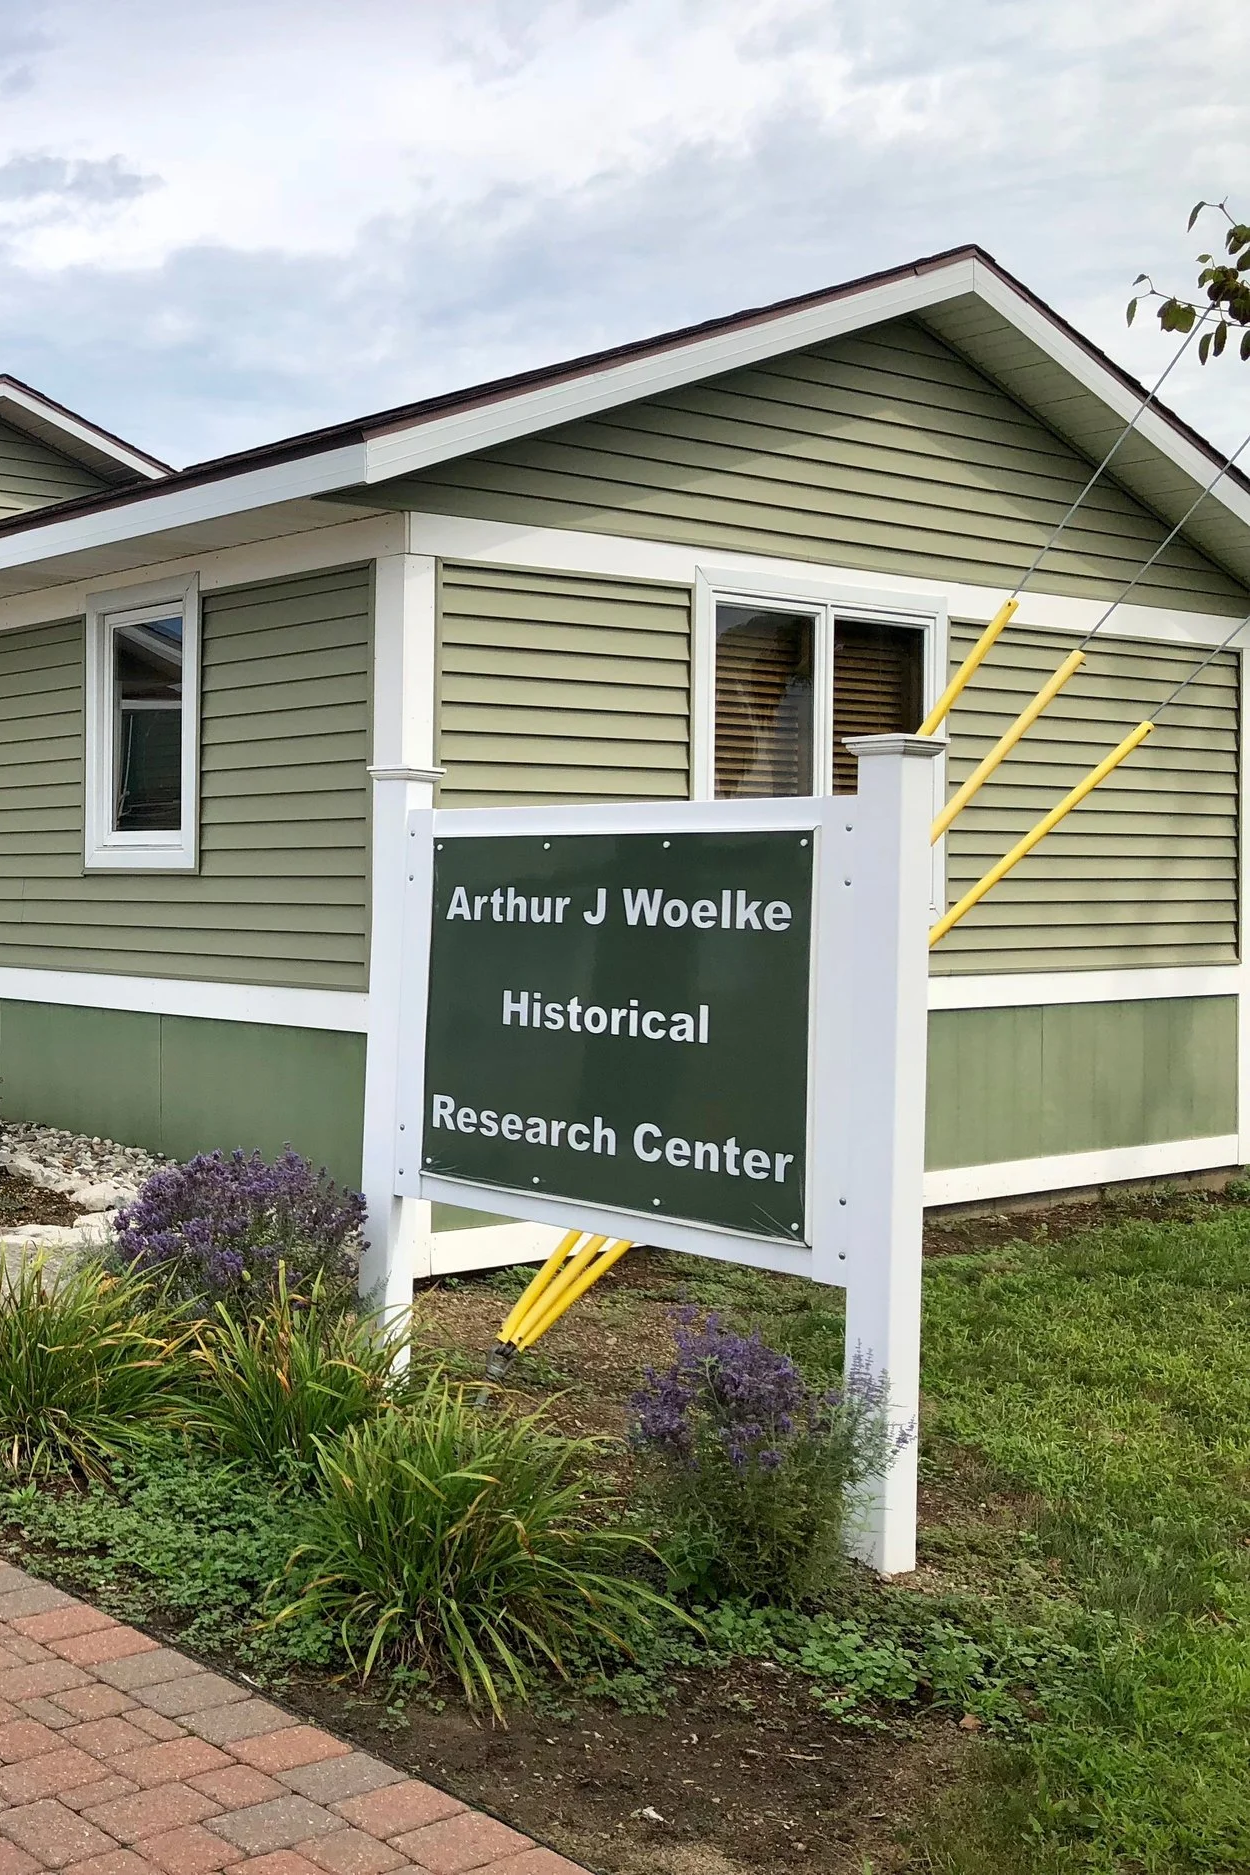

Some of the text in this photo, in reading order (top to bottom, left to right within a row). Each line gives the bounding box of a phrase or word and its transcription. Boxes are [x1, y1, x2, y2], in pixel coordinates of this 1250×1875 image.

[446, 886, 793, 932] Arthur J Woelke
[502, 989, 710, 1044] Historical
[432, 1093, 795, 1183] Research Center
